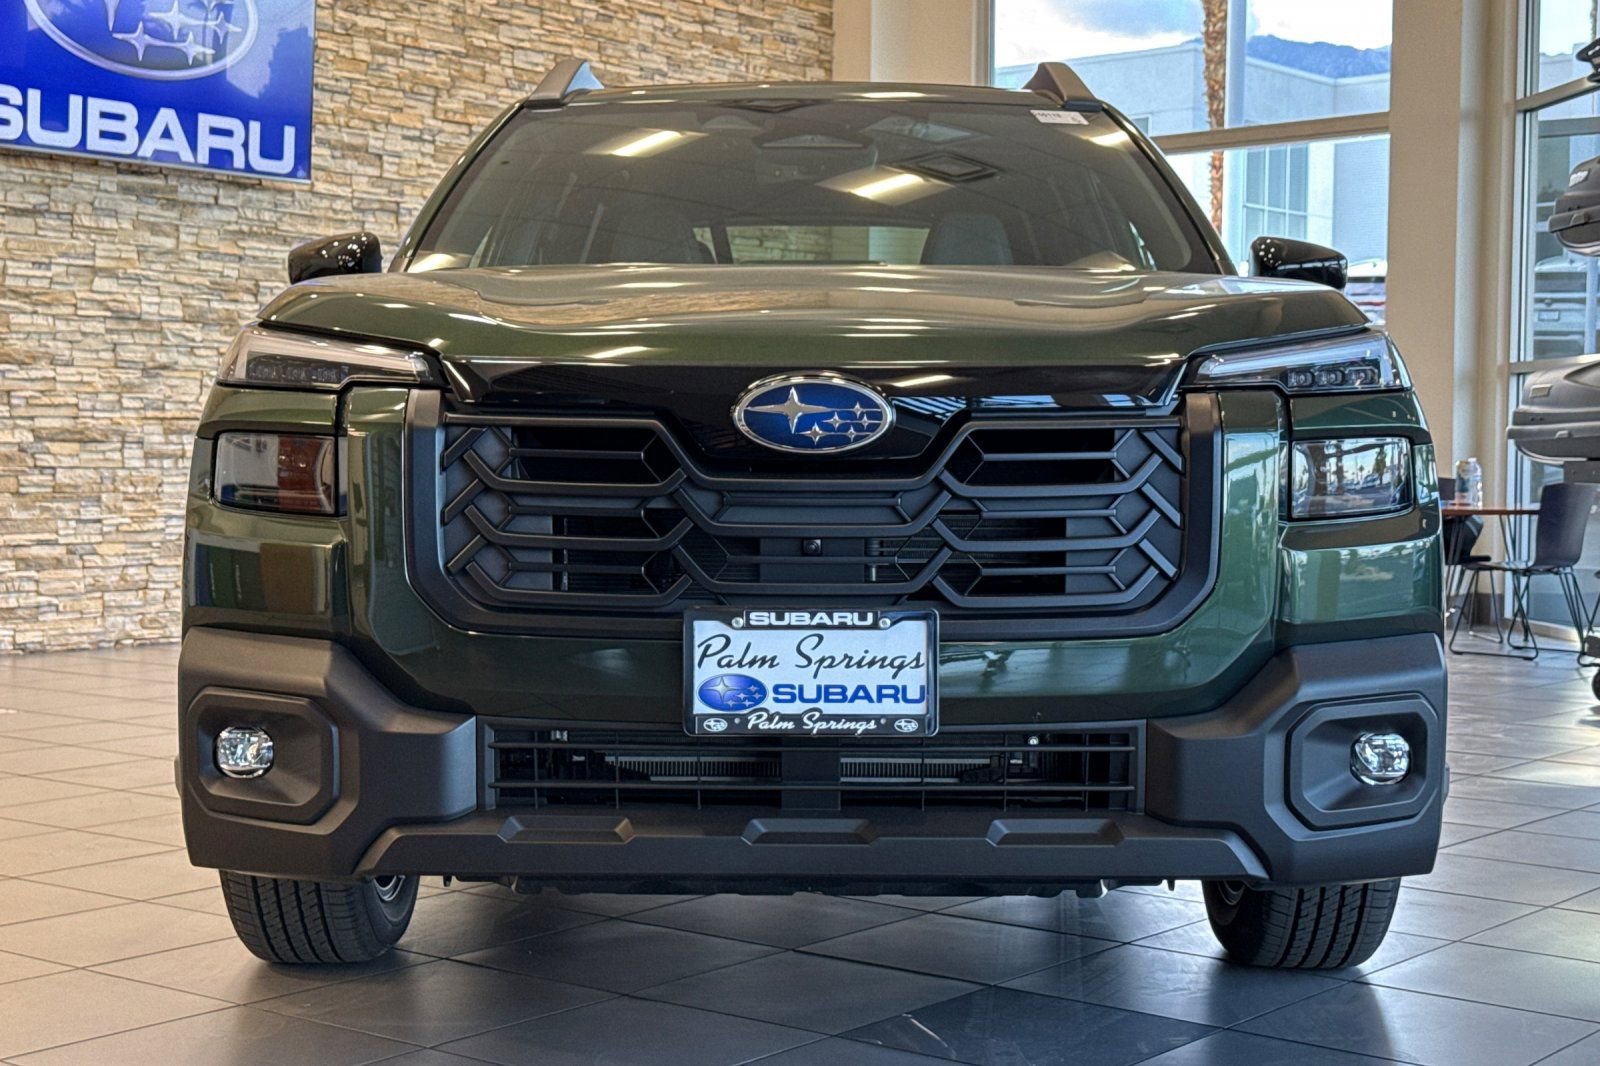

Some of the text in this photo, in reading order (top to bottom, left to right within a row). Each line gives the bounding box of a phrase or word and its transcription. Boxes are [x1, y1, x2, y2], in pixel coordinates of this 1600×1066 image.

[749, 612, 873, 626] SUBARU
[697, 633, 925, 679] Palm Springs
[772, 684, 926, 704] SUBARU
[747, 711, 877, 735] Palm Springs
